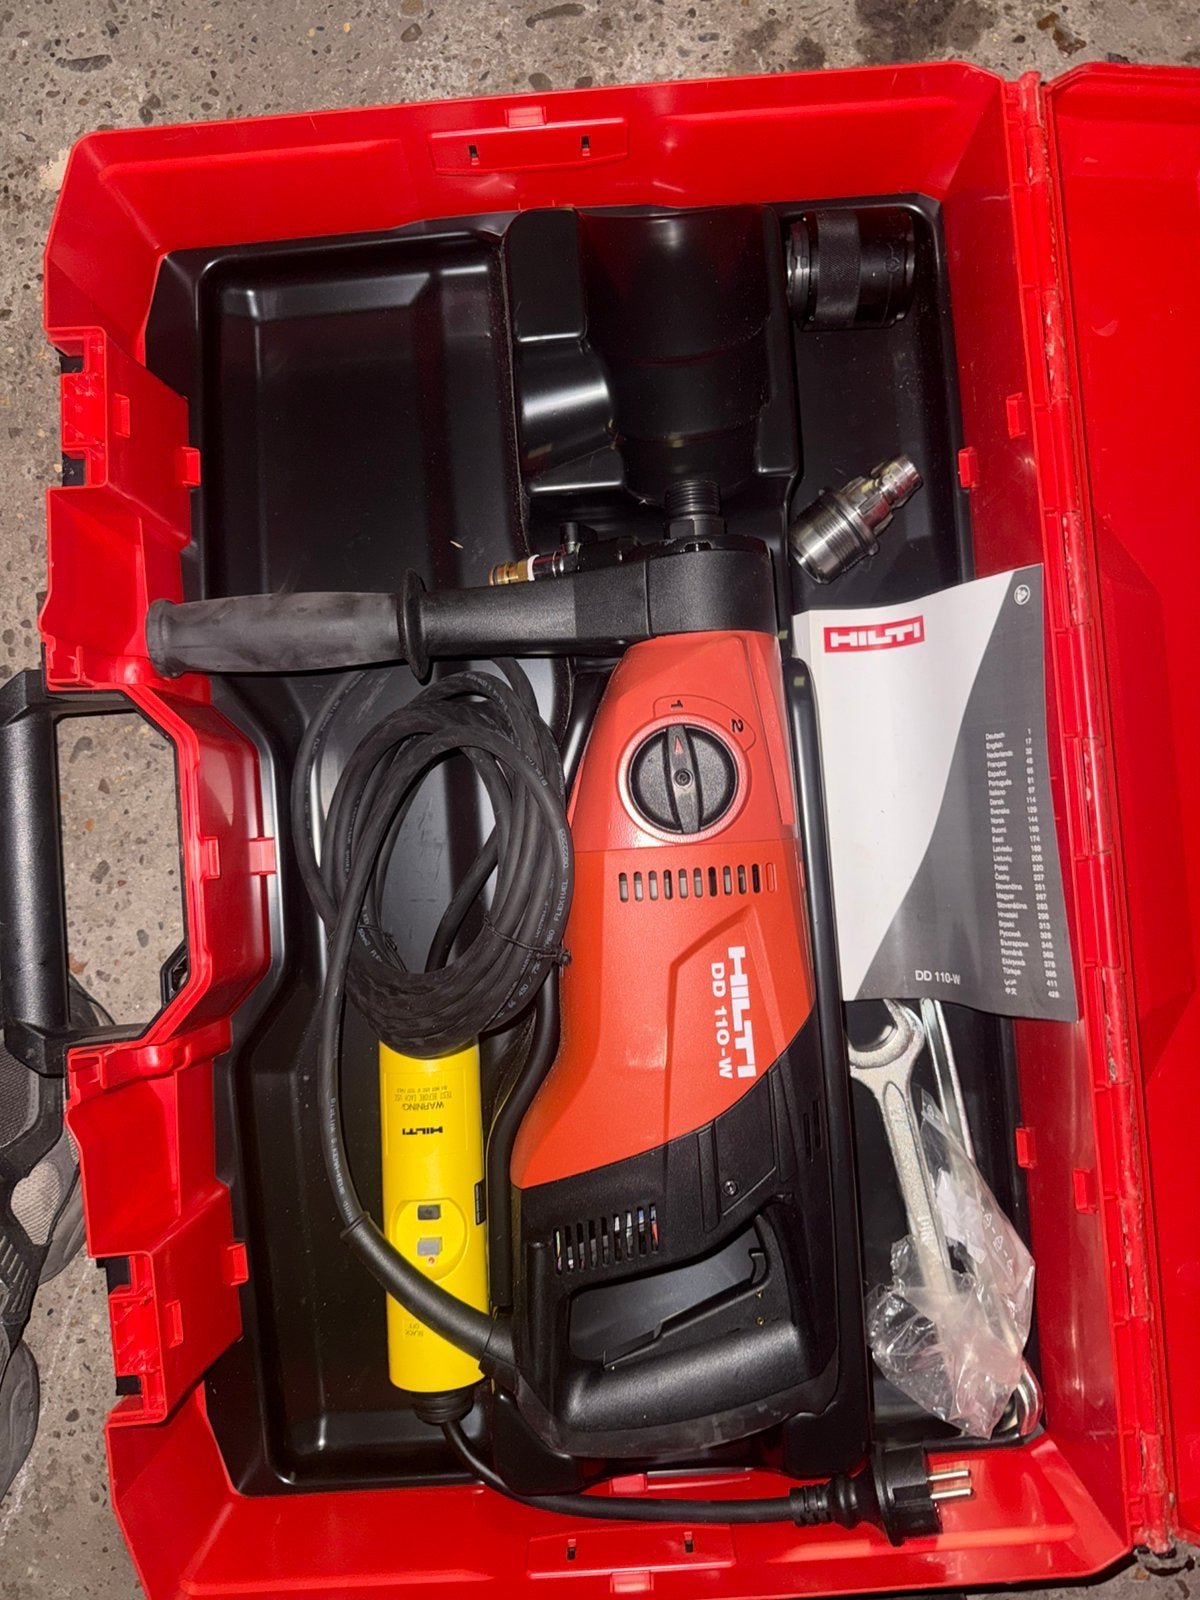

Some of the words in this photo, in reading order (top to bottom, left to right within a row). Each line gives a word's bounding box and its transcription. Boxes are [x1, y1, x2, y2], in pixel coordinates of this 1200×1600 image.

[830, 621, 920, 648] HILTI
[671, 699, 684, 709] 1
[731, 718, 744, 733] 2
[985, 732, 1005, 740] Deutsch
[986, 741, 1004, 750] English
[986, 750, 1014, 759] Nederlands
[988, 779, 1012, 788] Português
[989, 798, 1005, 806] Dansk
[991, 826, 1007, 834] Suomi
[996, 892, 1015, 900] Magyar
[711, 962, 726, 998] DD
[915, 970, 932, 981] DD
[934, 971, 961, 985] 110-W
[1046, 979, 1058, 987] 411
[728, 946, 757, 1078] HILTI
[715, 1005, 733, 1079] 110-W
[402, 1101, 444, 1111] WARNING
[402, 1126, 443, 1136] HILTI
